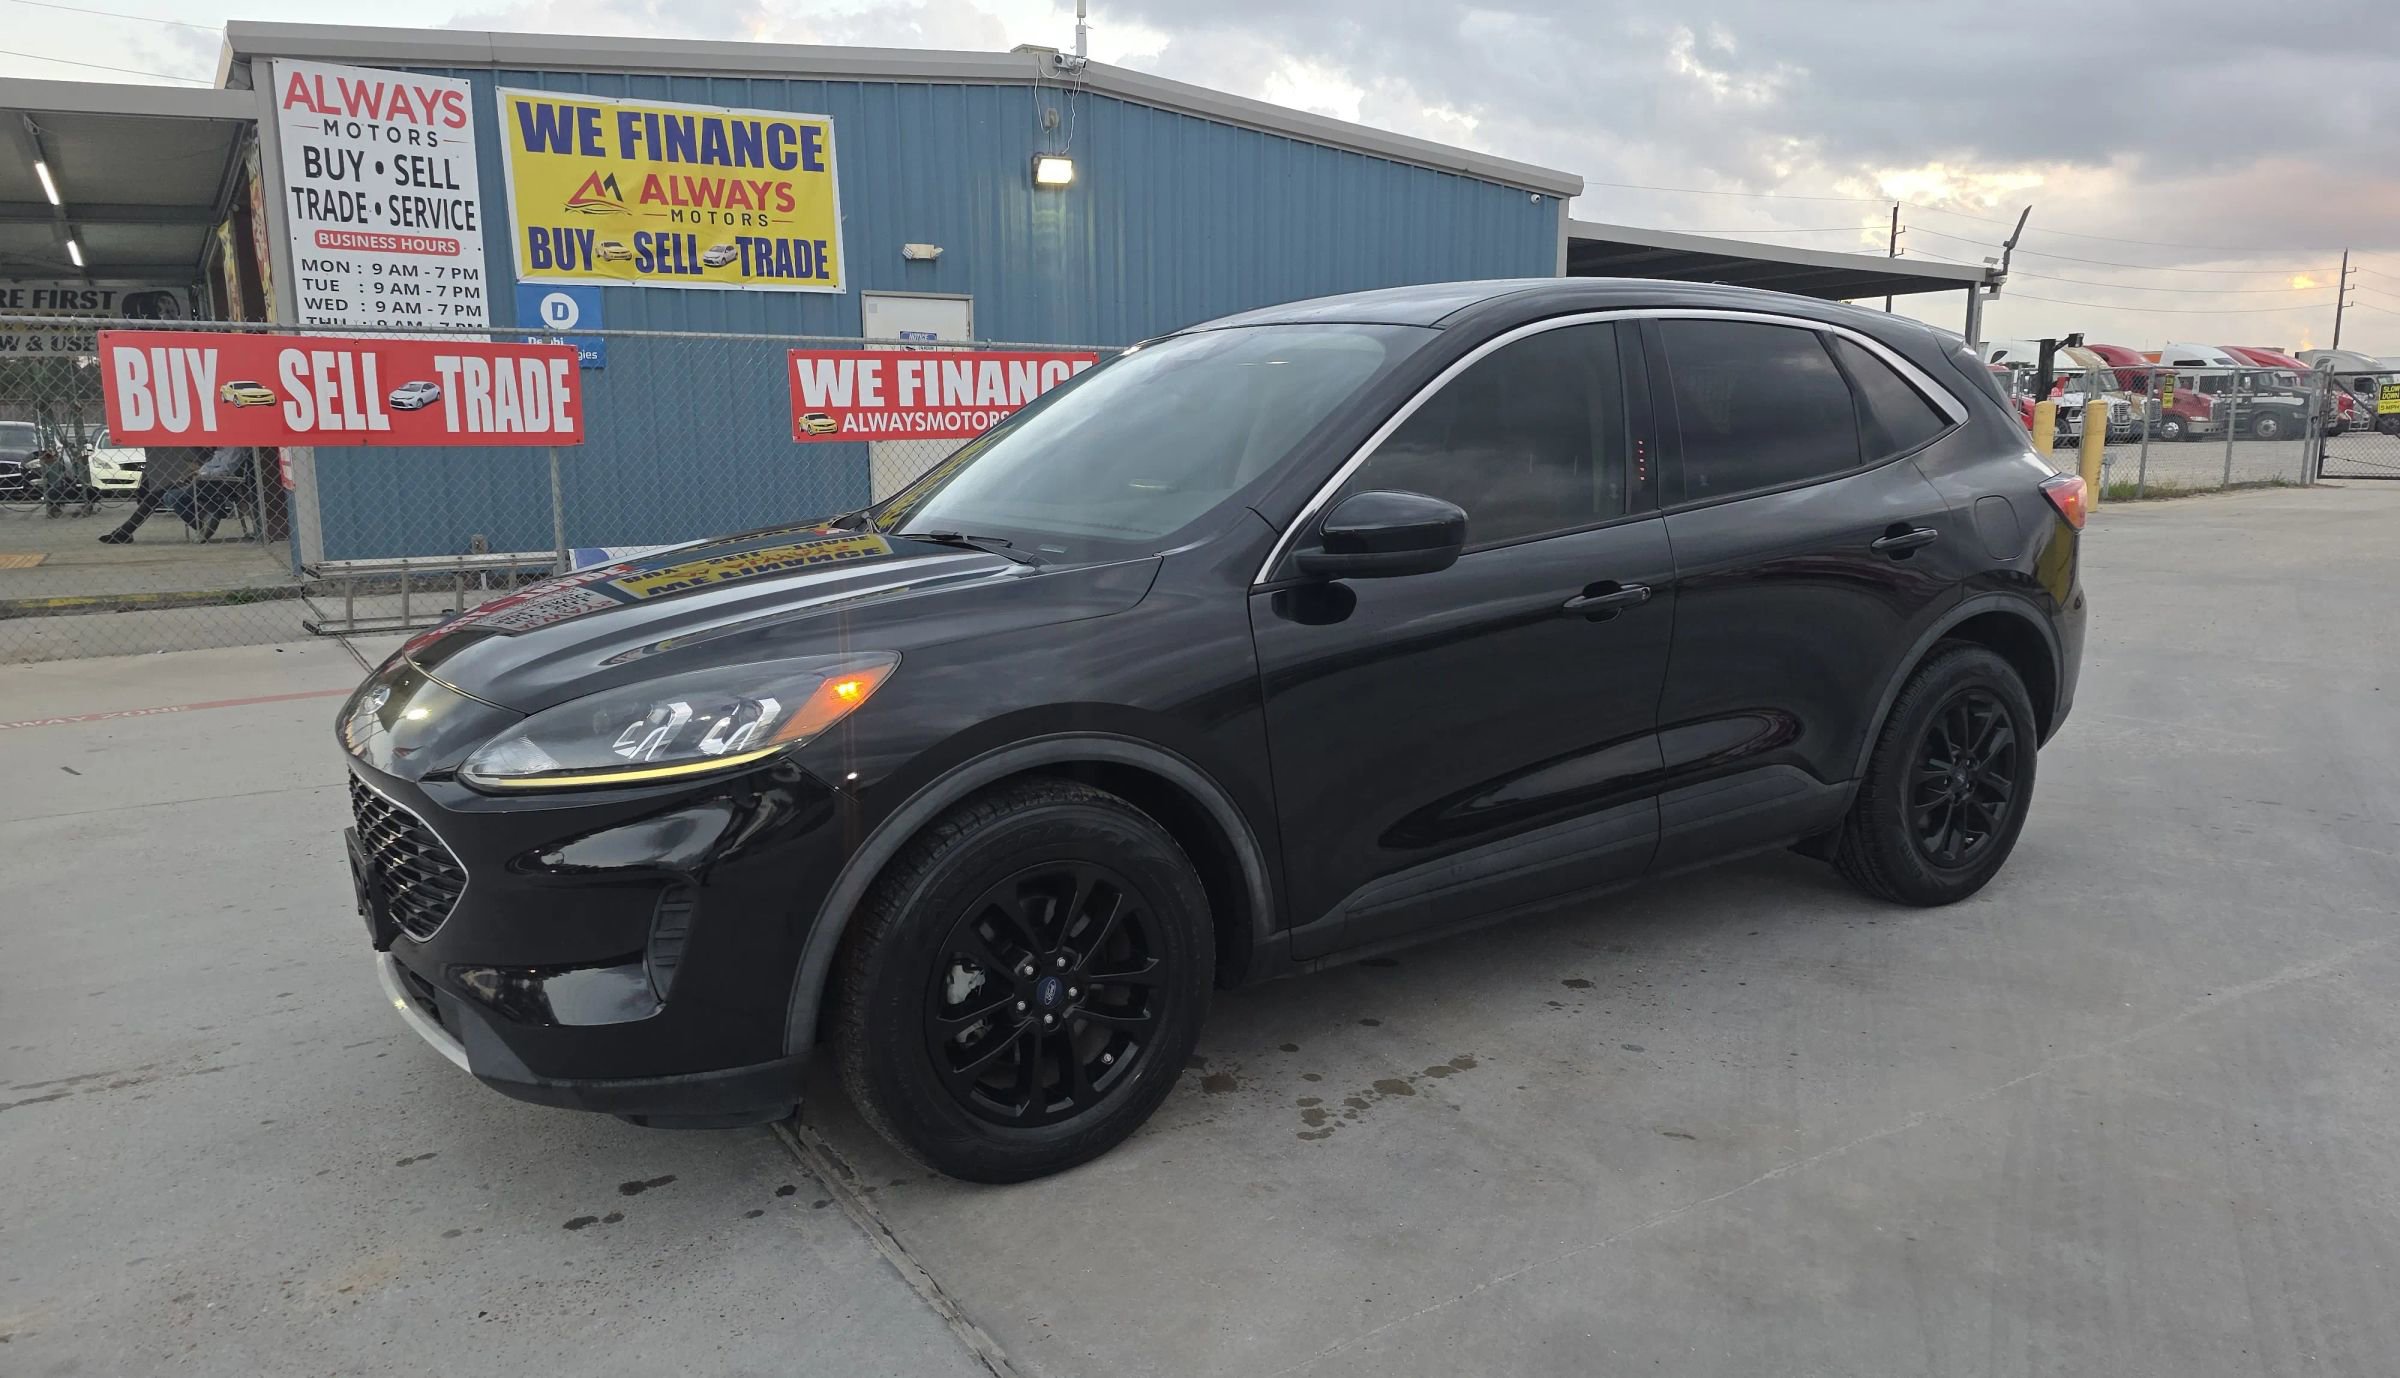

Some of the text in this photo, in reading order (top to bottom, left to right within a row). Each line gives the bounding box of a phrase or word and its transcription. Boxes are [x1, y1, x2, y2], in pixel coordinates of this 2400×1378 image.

[283, 71, 467, 129] ALWAYS
[323, 119, 438, 148] MOTORS
[516, 101, 825, 172] WE FINANCE
[303, 145, 364, 182] BUY
[394, 155, 460, 190] SELL
[291, 186, 368, 224] TRADE
[389, 194, 476, 231] SERVICE
[639, 173, 796, 212] ALWAYS
[671, 209, 769, 227] MOTORS
[318, 233, 456, 253] BUSINESS HOURS
[528, 226, 830, 279] BUY SELL TRADE
[301, 258, 350, 274] MON
[372, 263, 383, 275] 9
[388, 264, 419, 277] AM
[435, 266, 445, 279] 7
[452, 268, 479, 280] PM
[32, 289, 117, 310] FIRST
[302, 278, 340, 292] TUE
[373, 282, 384, 294] 9
[390, 283, 420, 296] AM
[437, 285, 446, 297] 7
[453, 286, 480, 299] PM
[304, 297, 348, 311] WED
[375, 301, 386, 313] 9
[392, 302, 422, 314] AM
[438, 304, 448, 315] 7
[454, 305, 482, 317] PM
[528, 337, 564, 345] Dehi
[113, 346, 574, 433] BUY SELL TRADE
[797, 359, 1093, 407] WE FINANC
